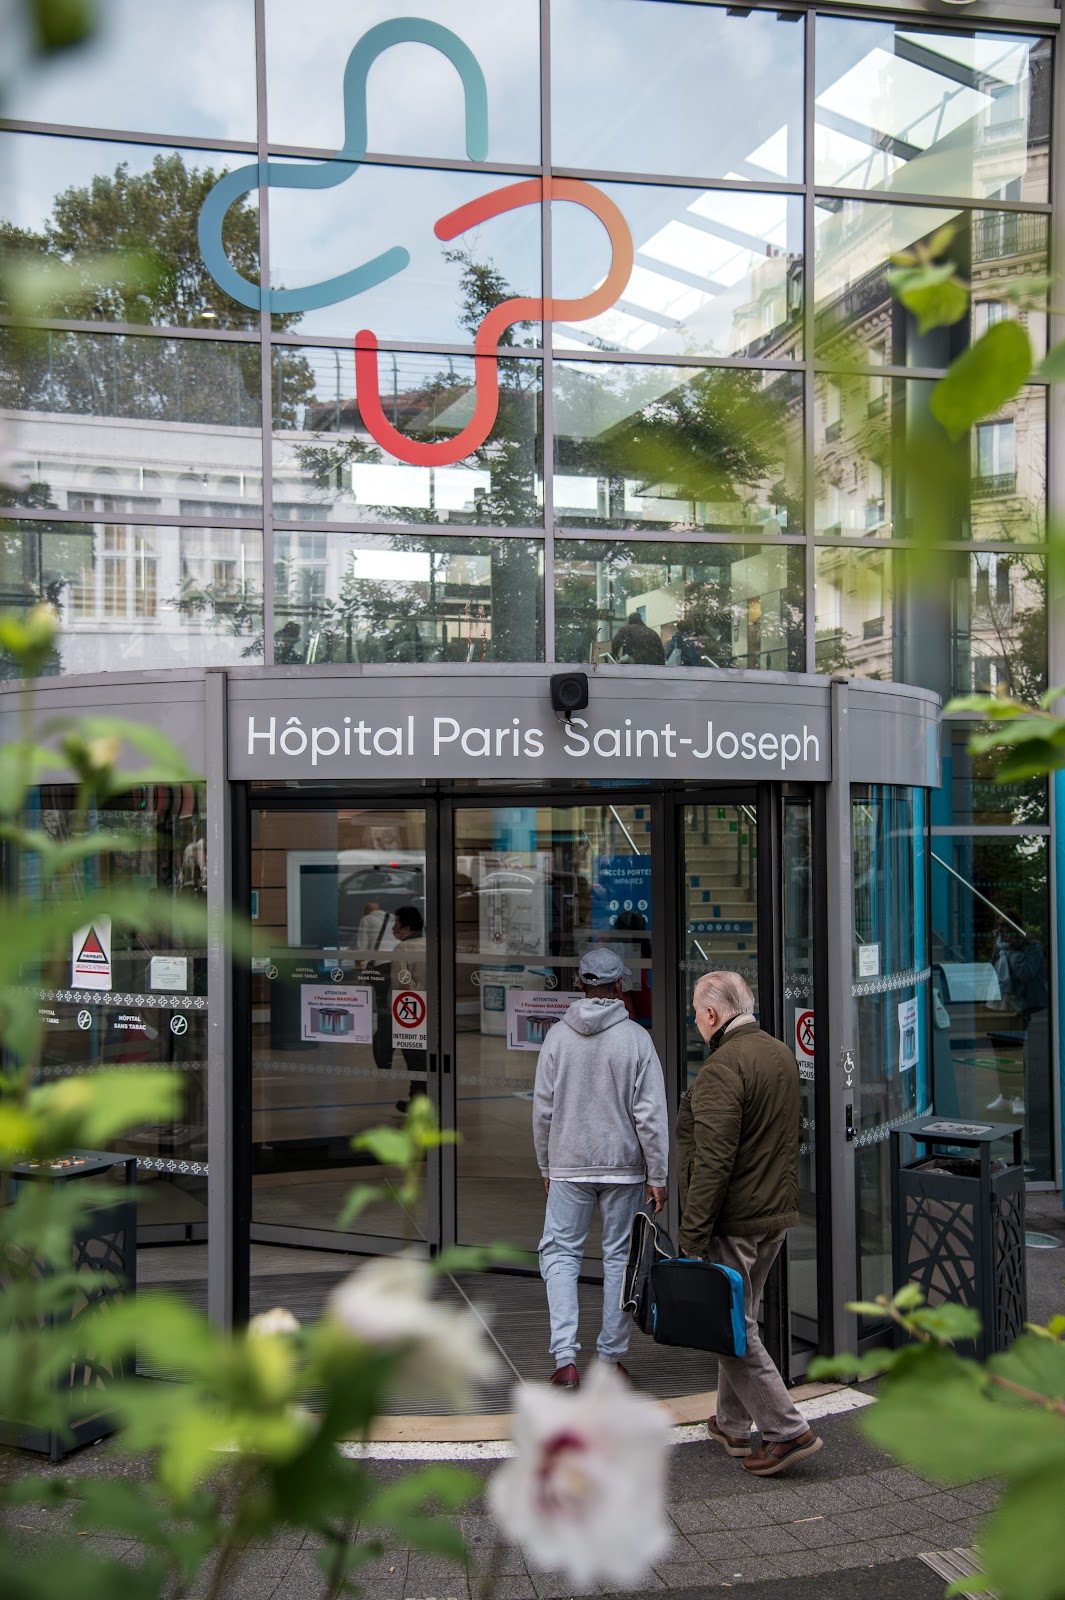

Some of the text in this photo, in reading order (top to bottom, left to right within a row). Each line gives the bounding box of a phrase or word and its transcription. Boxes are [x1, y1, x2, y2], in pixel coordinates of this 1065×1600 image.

[248, 716, 819, 770] Hôpital Paris Saint-Joseph
[604, 868, 625, 876] ACCÈS
[396, 1041, 423, 1049] POUSSER
[800, 1070, 815, 1078] POUS
